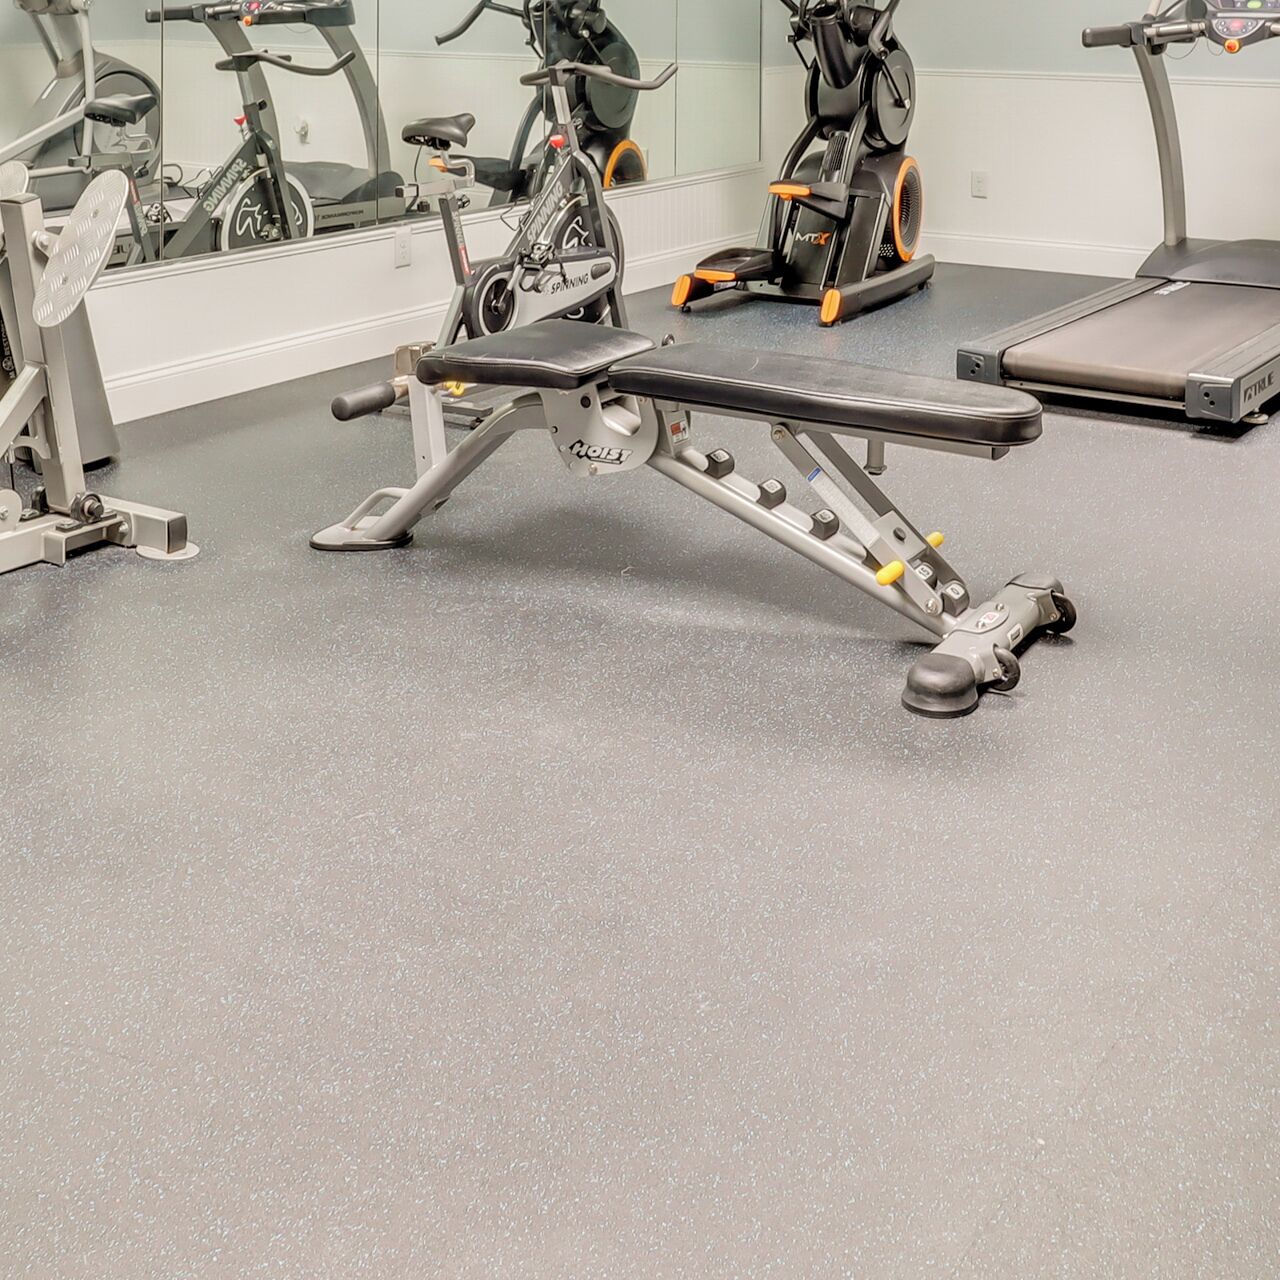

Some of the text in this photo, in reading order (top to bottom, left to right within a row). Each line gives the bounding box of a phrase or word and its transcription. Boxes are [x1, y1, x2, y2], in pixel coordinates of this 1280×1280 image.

[526, 181, 564, 244] SPINNING
[795, 231, 831, 245] MTX
[551, 273, 589, 295] SPINNING
[1251, 371, 1274, 397] TRUE
[571, 442, 633, 462] HOIST
